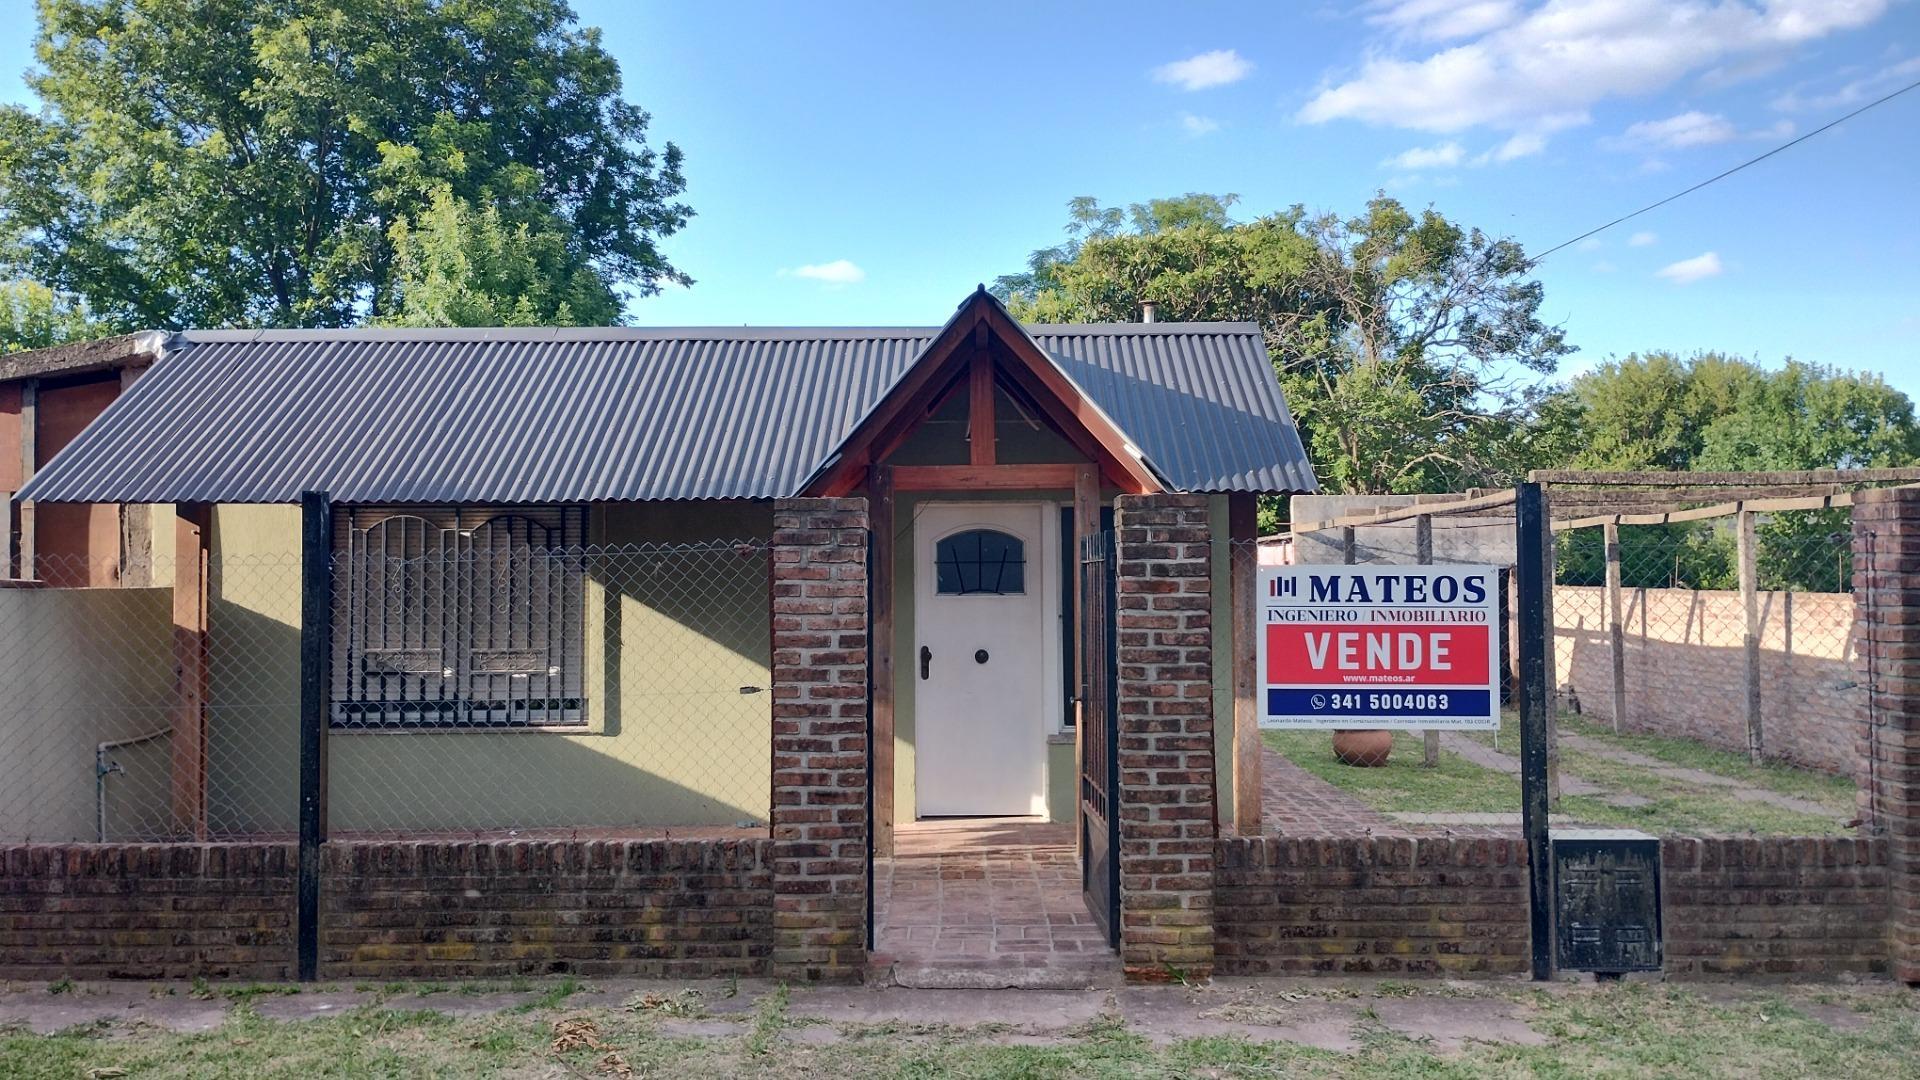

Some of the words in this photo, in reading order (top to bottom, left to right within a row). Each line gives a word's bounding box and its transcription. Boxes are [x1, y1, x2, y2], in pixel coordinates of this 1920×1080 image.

[1309, 575, 1486, 603] MATEOS
[1268, 609, 1358, 622] INGENIERO
[1370, 610, 1486, 622] INMOBILIARIO
[1304, 632, 1452, 670] VENDE
[1343, 674, 1415, 683] www.mateos.ar
[1331, 694, 1361, 709] 341
[1369, 694, 1449, 710] 5004063
